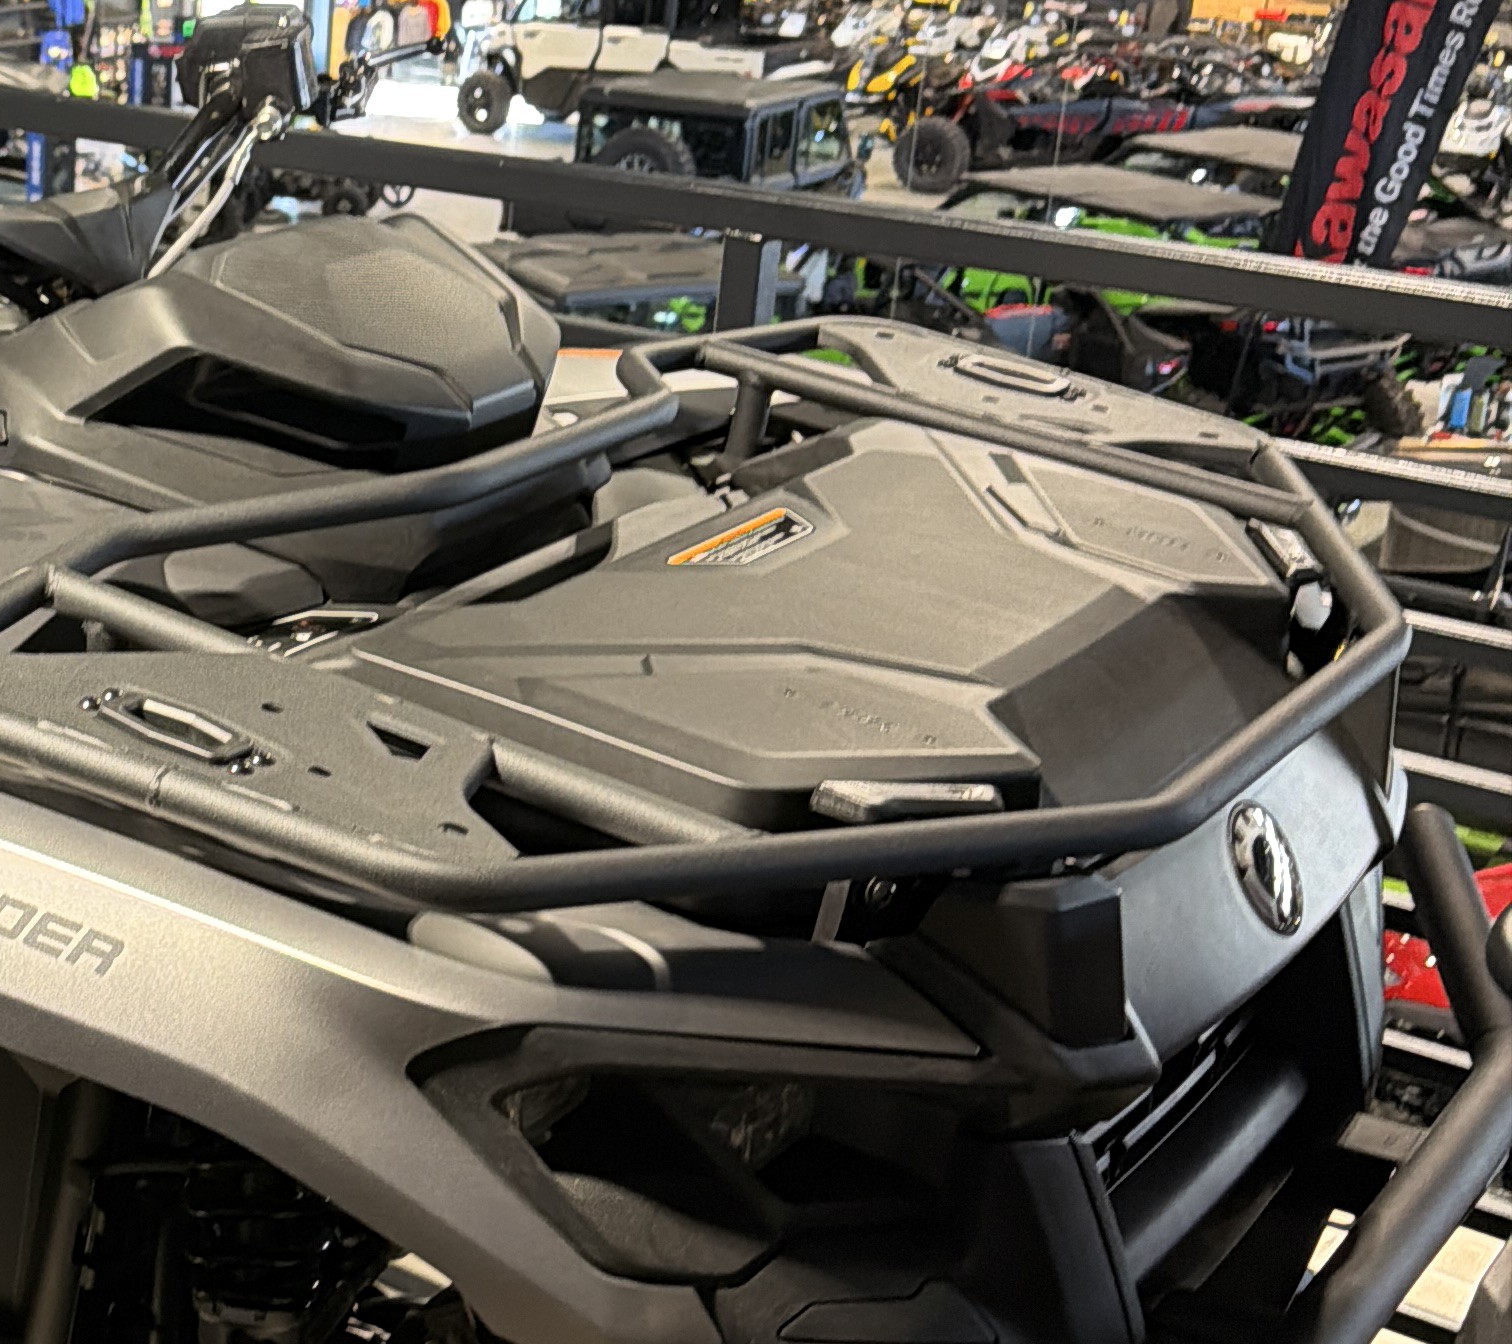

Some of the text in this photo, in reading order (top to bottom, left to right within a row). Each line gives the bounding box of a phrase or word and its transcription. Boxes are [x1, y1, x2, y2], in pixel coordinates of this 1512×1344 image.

[1357, 204, 1389, 255] the
[1375, 120, 1426, 205] Good
[1408, 30, 1466, 122] Times
